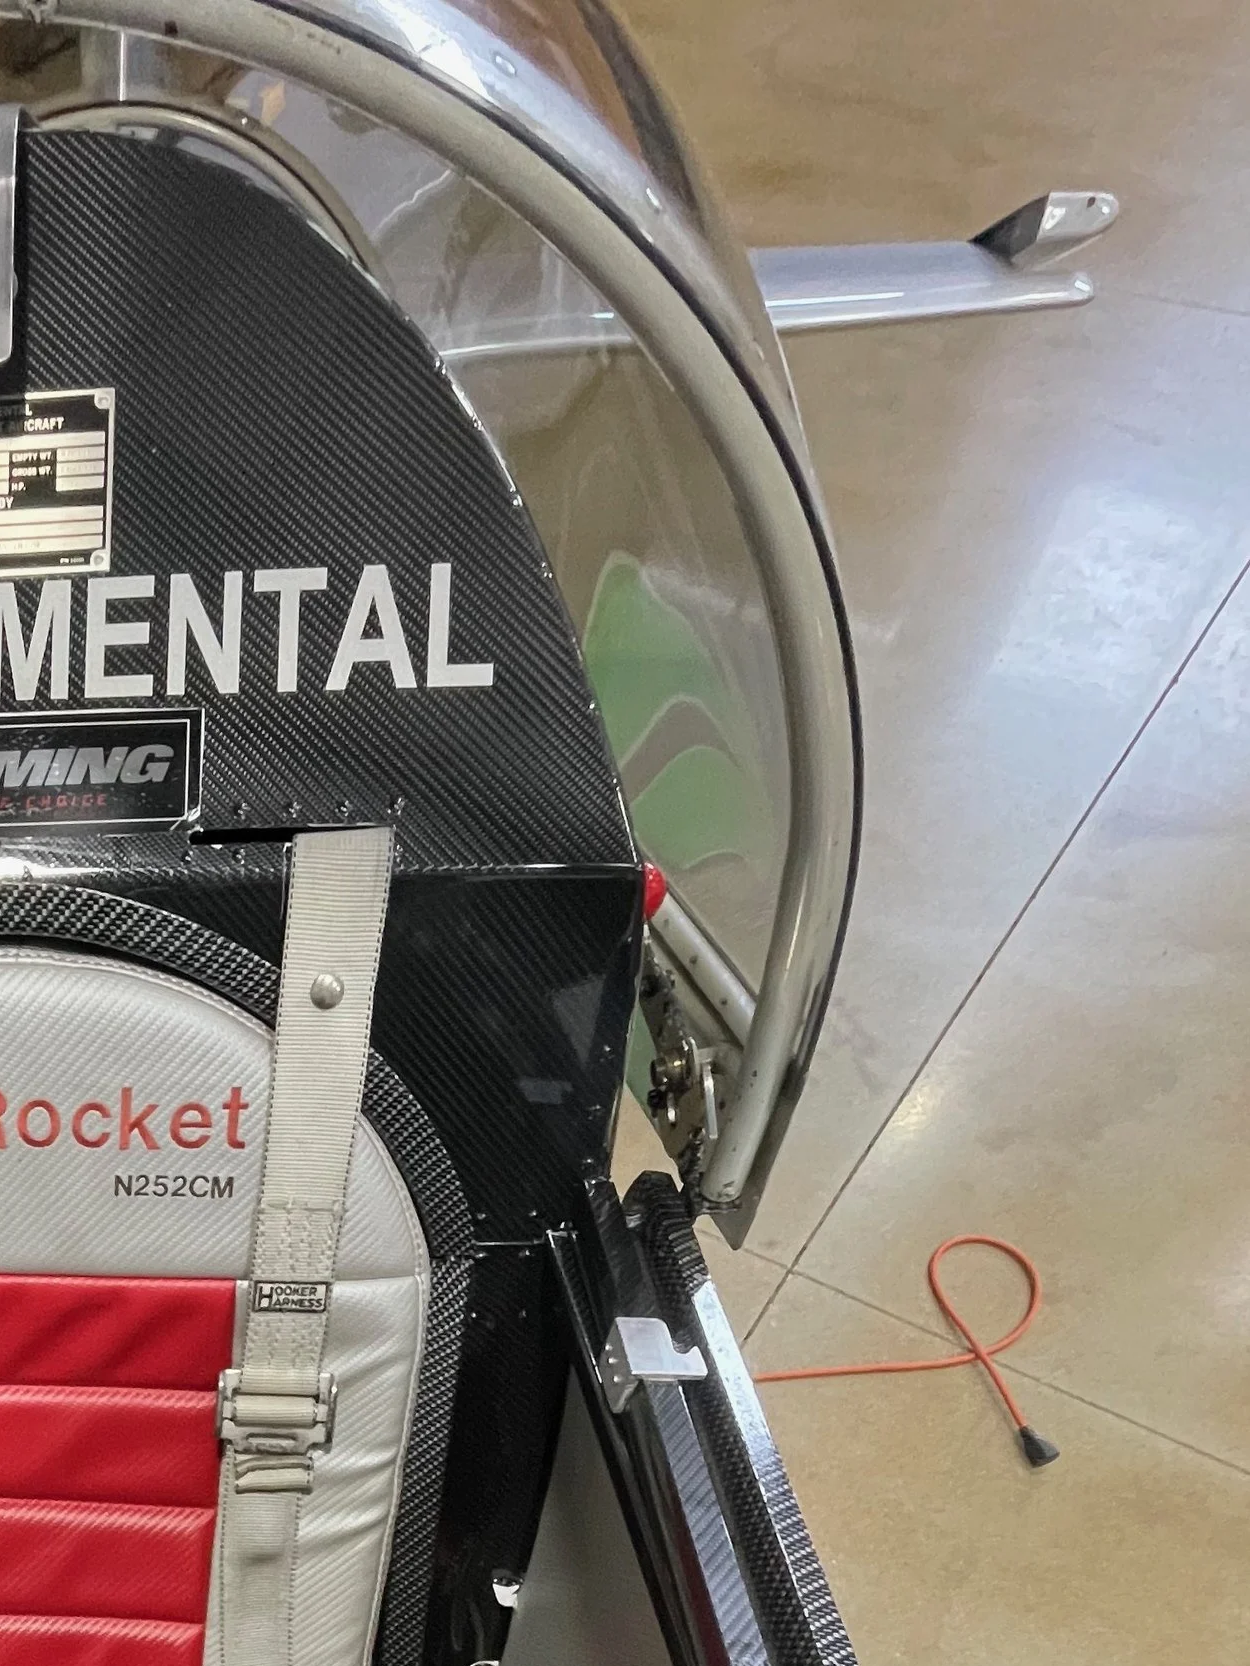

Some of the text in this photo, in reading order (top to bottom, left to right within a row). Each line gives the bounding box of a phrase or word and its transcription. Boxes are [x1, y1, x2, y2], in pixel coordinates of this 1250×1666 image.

[9, 416, 64, 433] AIRCRAFT
[12, 452, 38, 463] EMPTY
[12, 466, 38, 477] GROSS
[113, 1174, 234, 1199] N252CM
[258, 1285, 318, 1302] HOOKER
